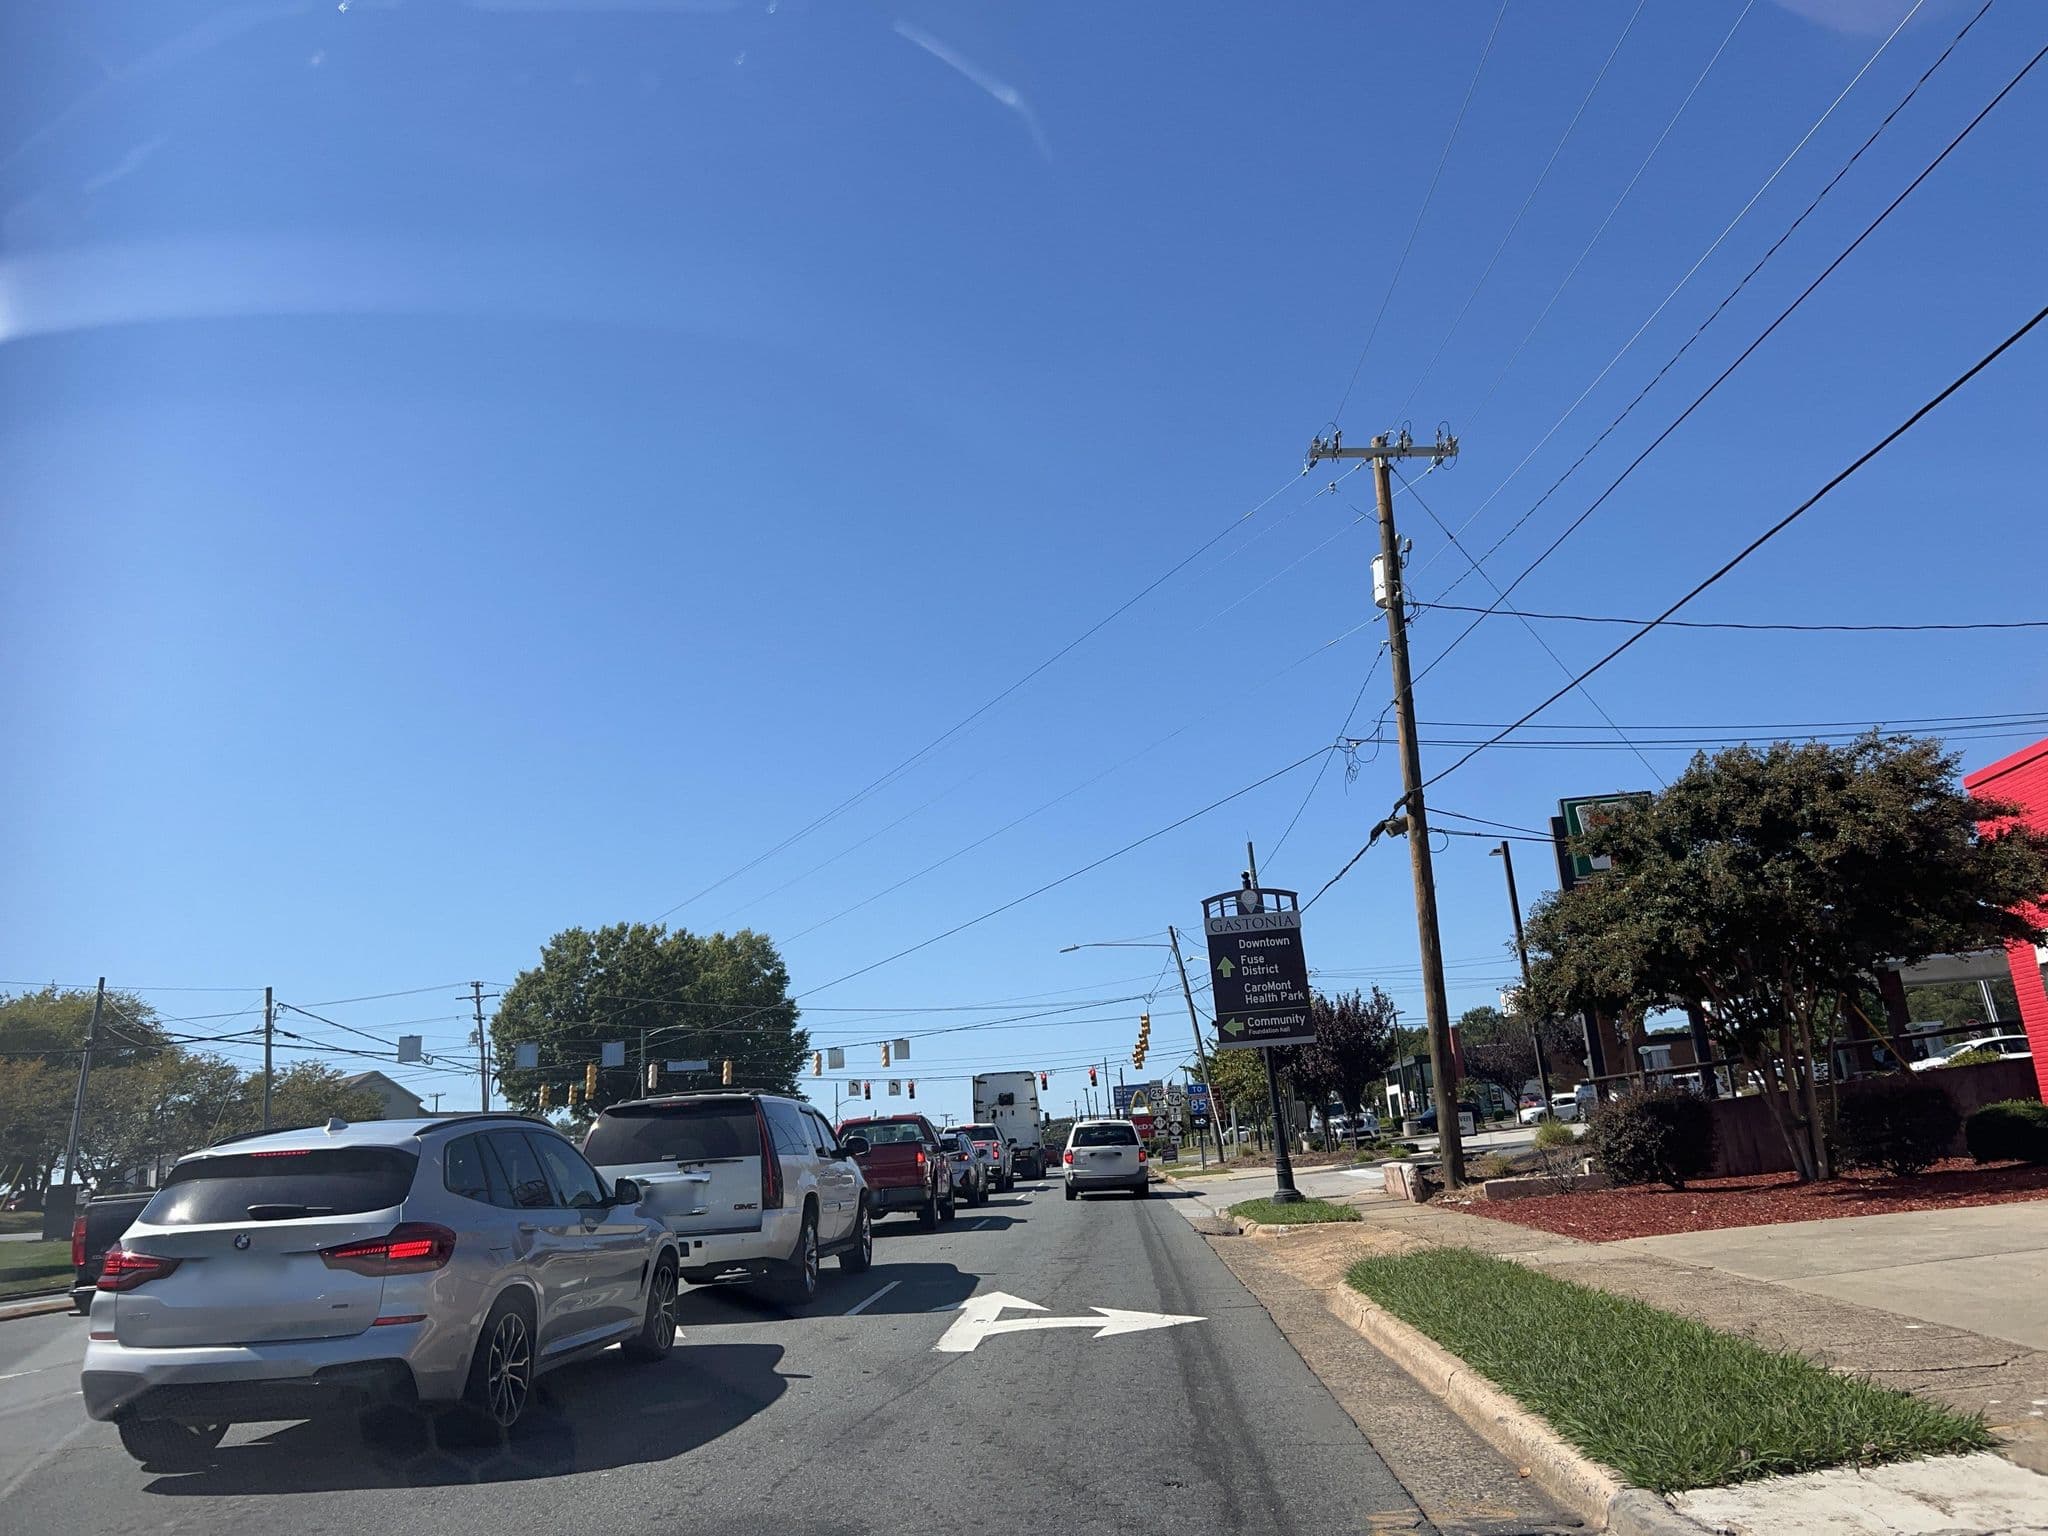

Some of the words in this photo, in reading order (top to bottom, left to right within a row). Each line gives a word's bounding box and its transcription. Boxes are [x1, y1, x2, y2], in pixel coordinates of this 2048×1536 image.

[1210, 915, 1294, 932] GASTONIA
[1238, 937, 1290, 949] Downtown
[1240, 954, 1265, 965] Fuse
[1241, 963, 1279, 976] District
[1244, 980, 1292, 993] CaroMont
[1245, 992, 1278, 1005] Health
[1280, 990, 1305, 1001] Park
[1247, 1013, 1306, 1027] Community
[1151, 1088, 1162, 1098] 29
[1169, 1094, 1180, 1103] 74
[1190, 1099, 1207, 1111] 85
[733, 1202, 758, 1210] GMC
